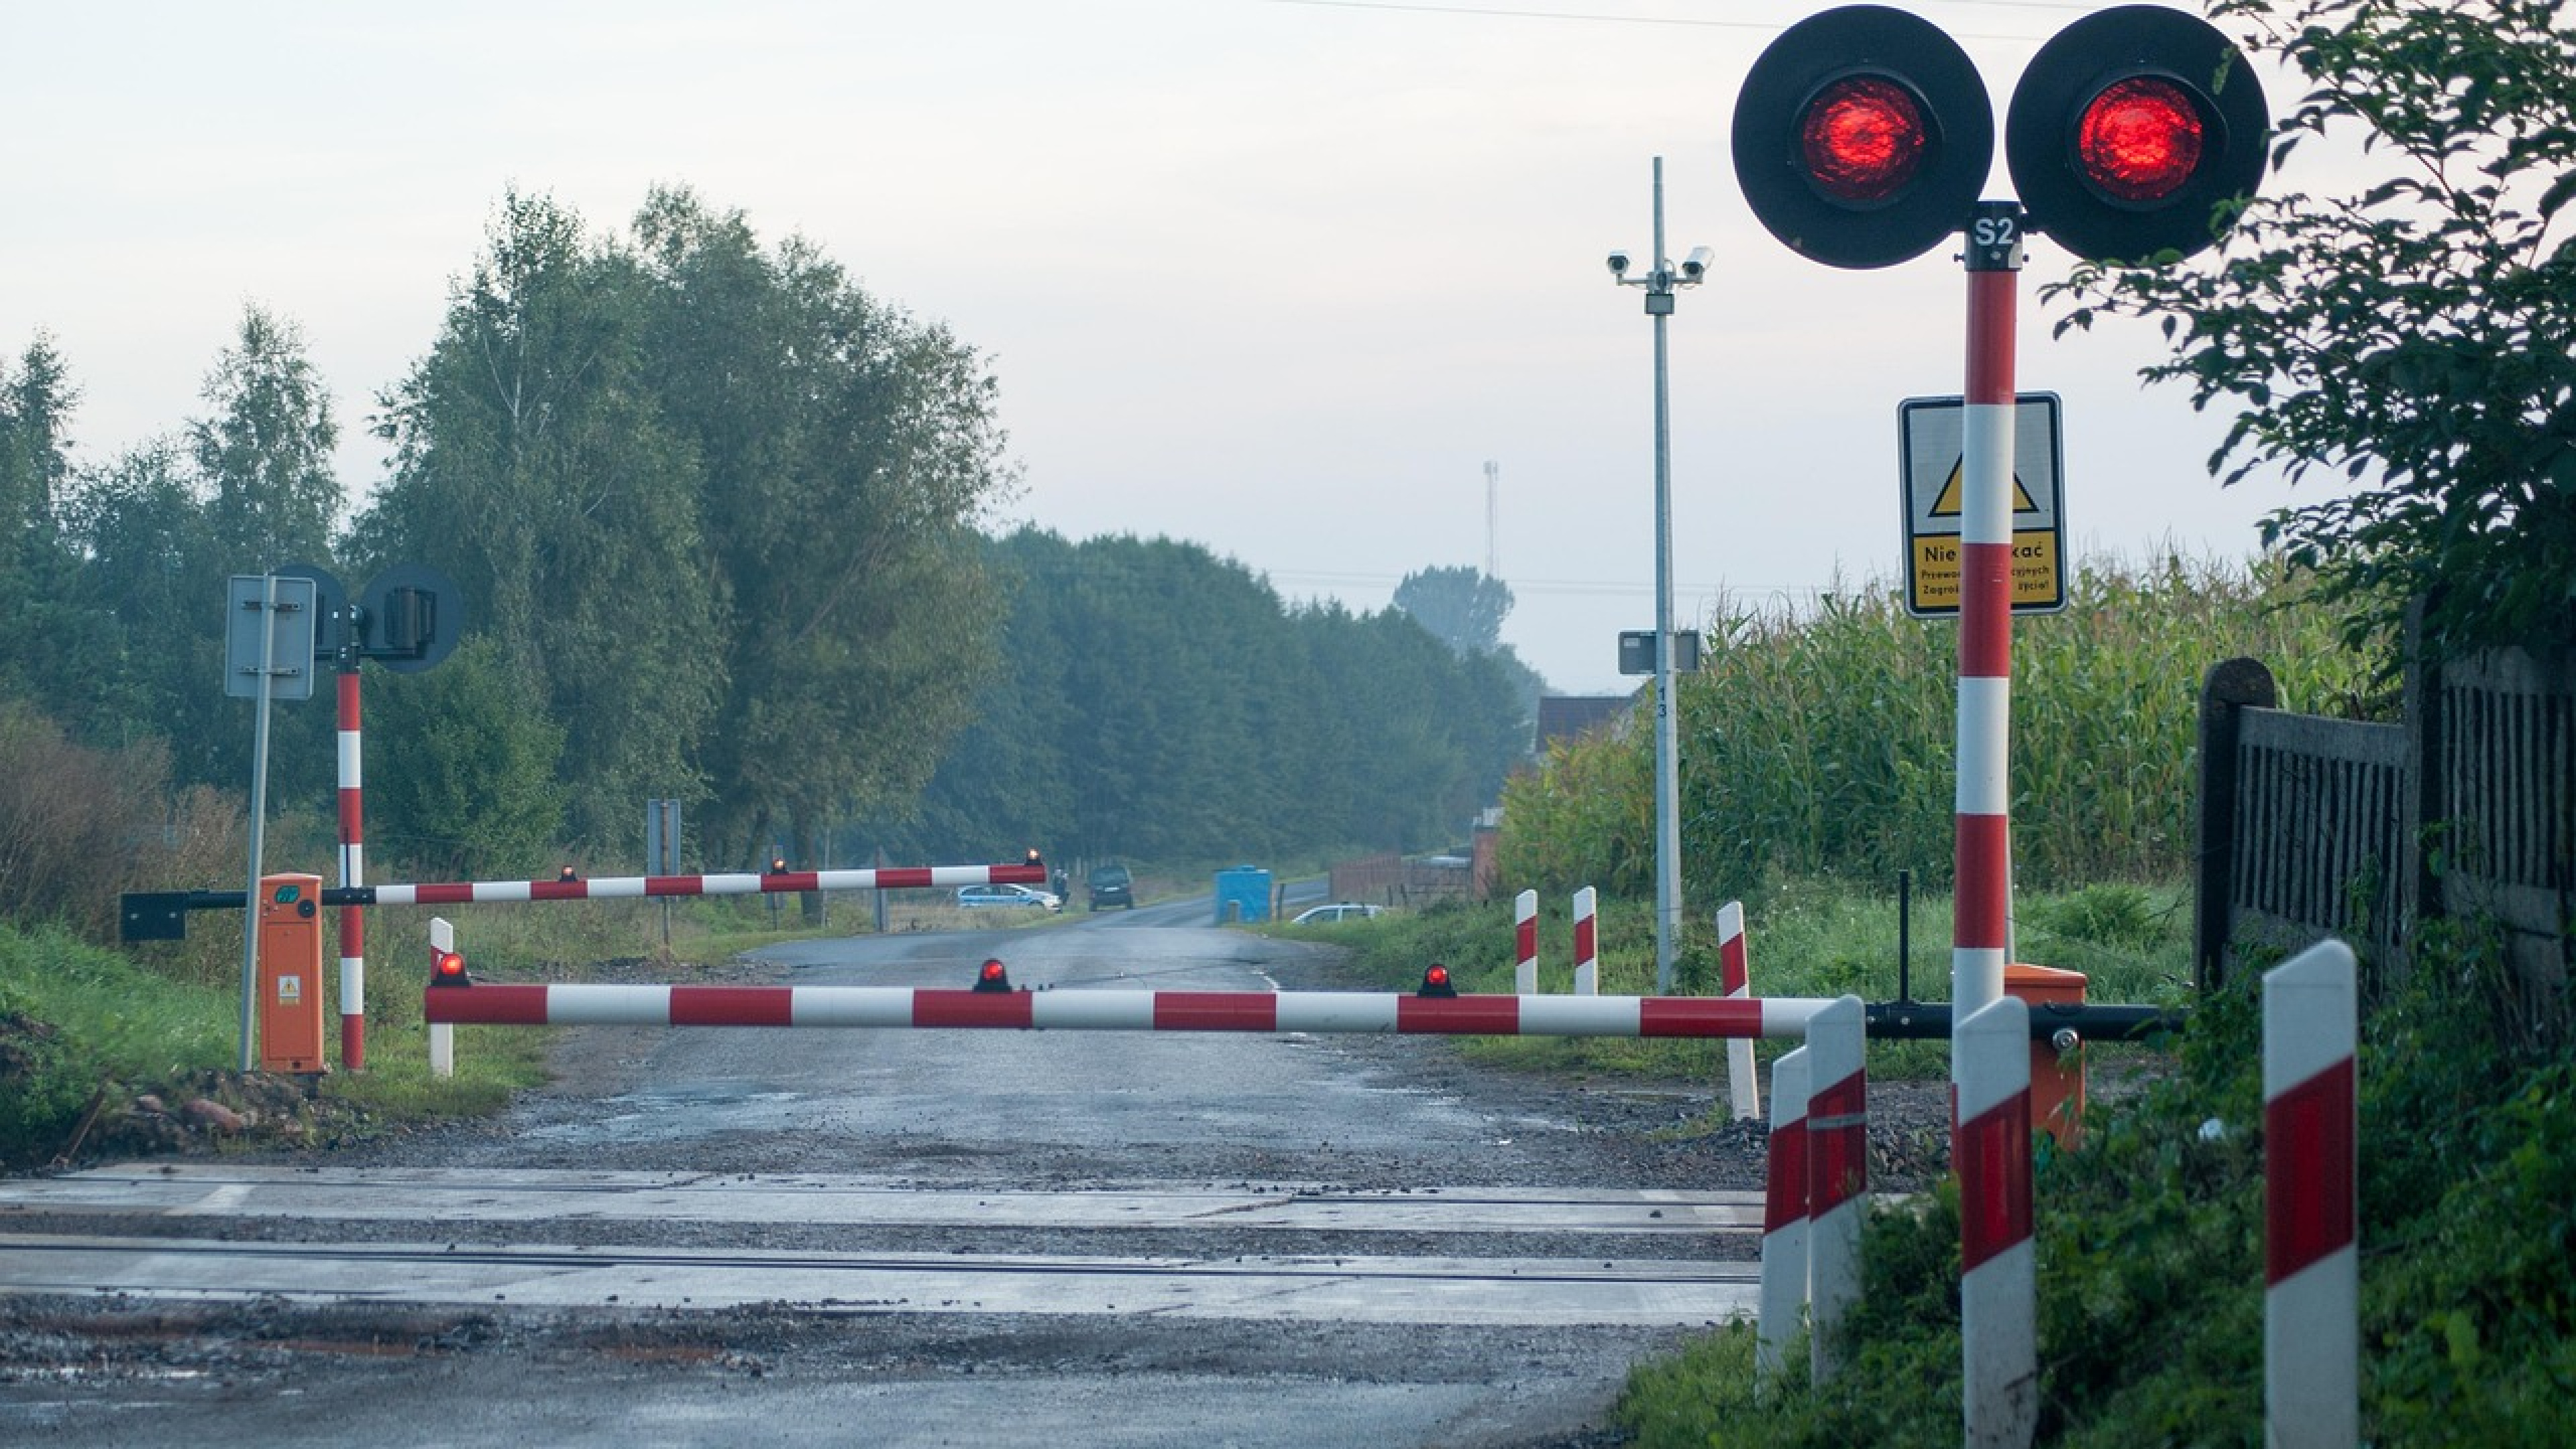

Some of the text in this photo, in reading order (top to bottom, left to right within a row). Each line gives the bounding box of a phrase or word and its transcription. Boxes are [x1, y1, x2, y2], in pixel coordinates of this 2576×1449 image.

[1976, 217, 2013, 246] S2
[1925, 545, 1957, 561] Nie
[1921, 569, 1960, 580] Przewo
